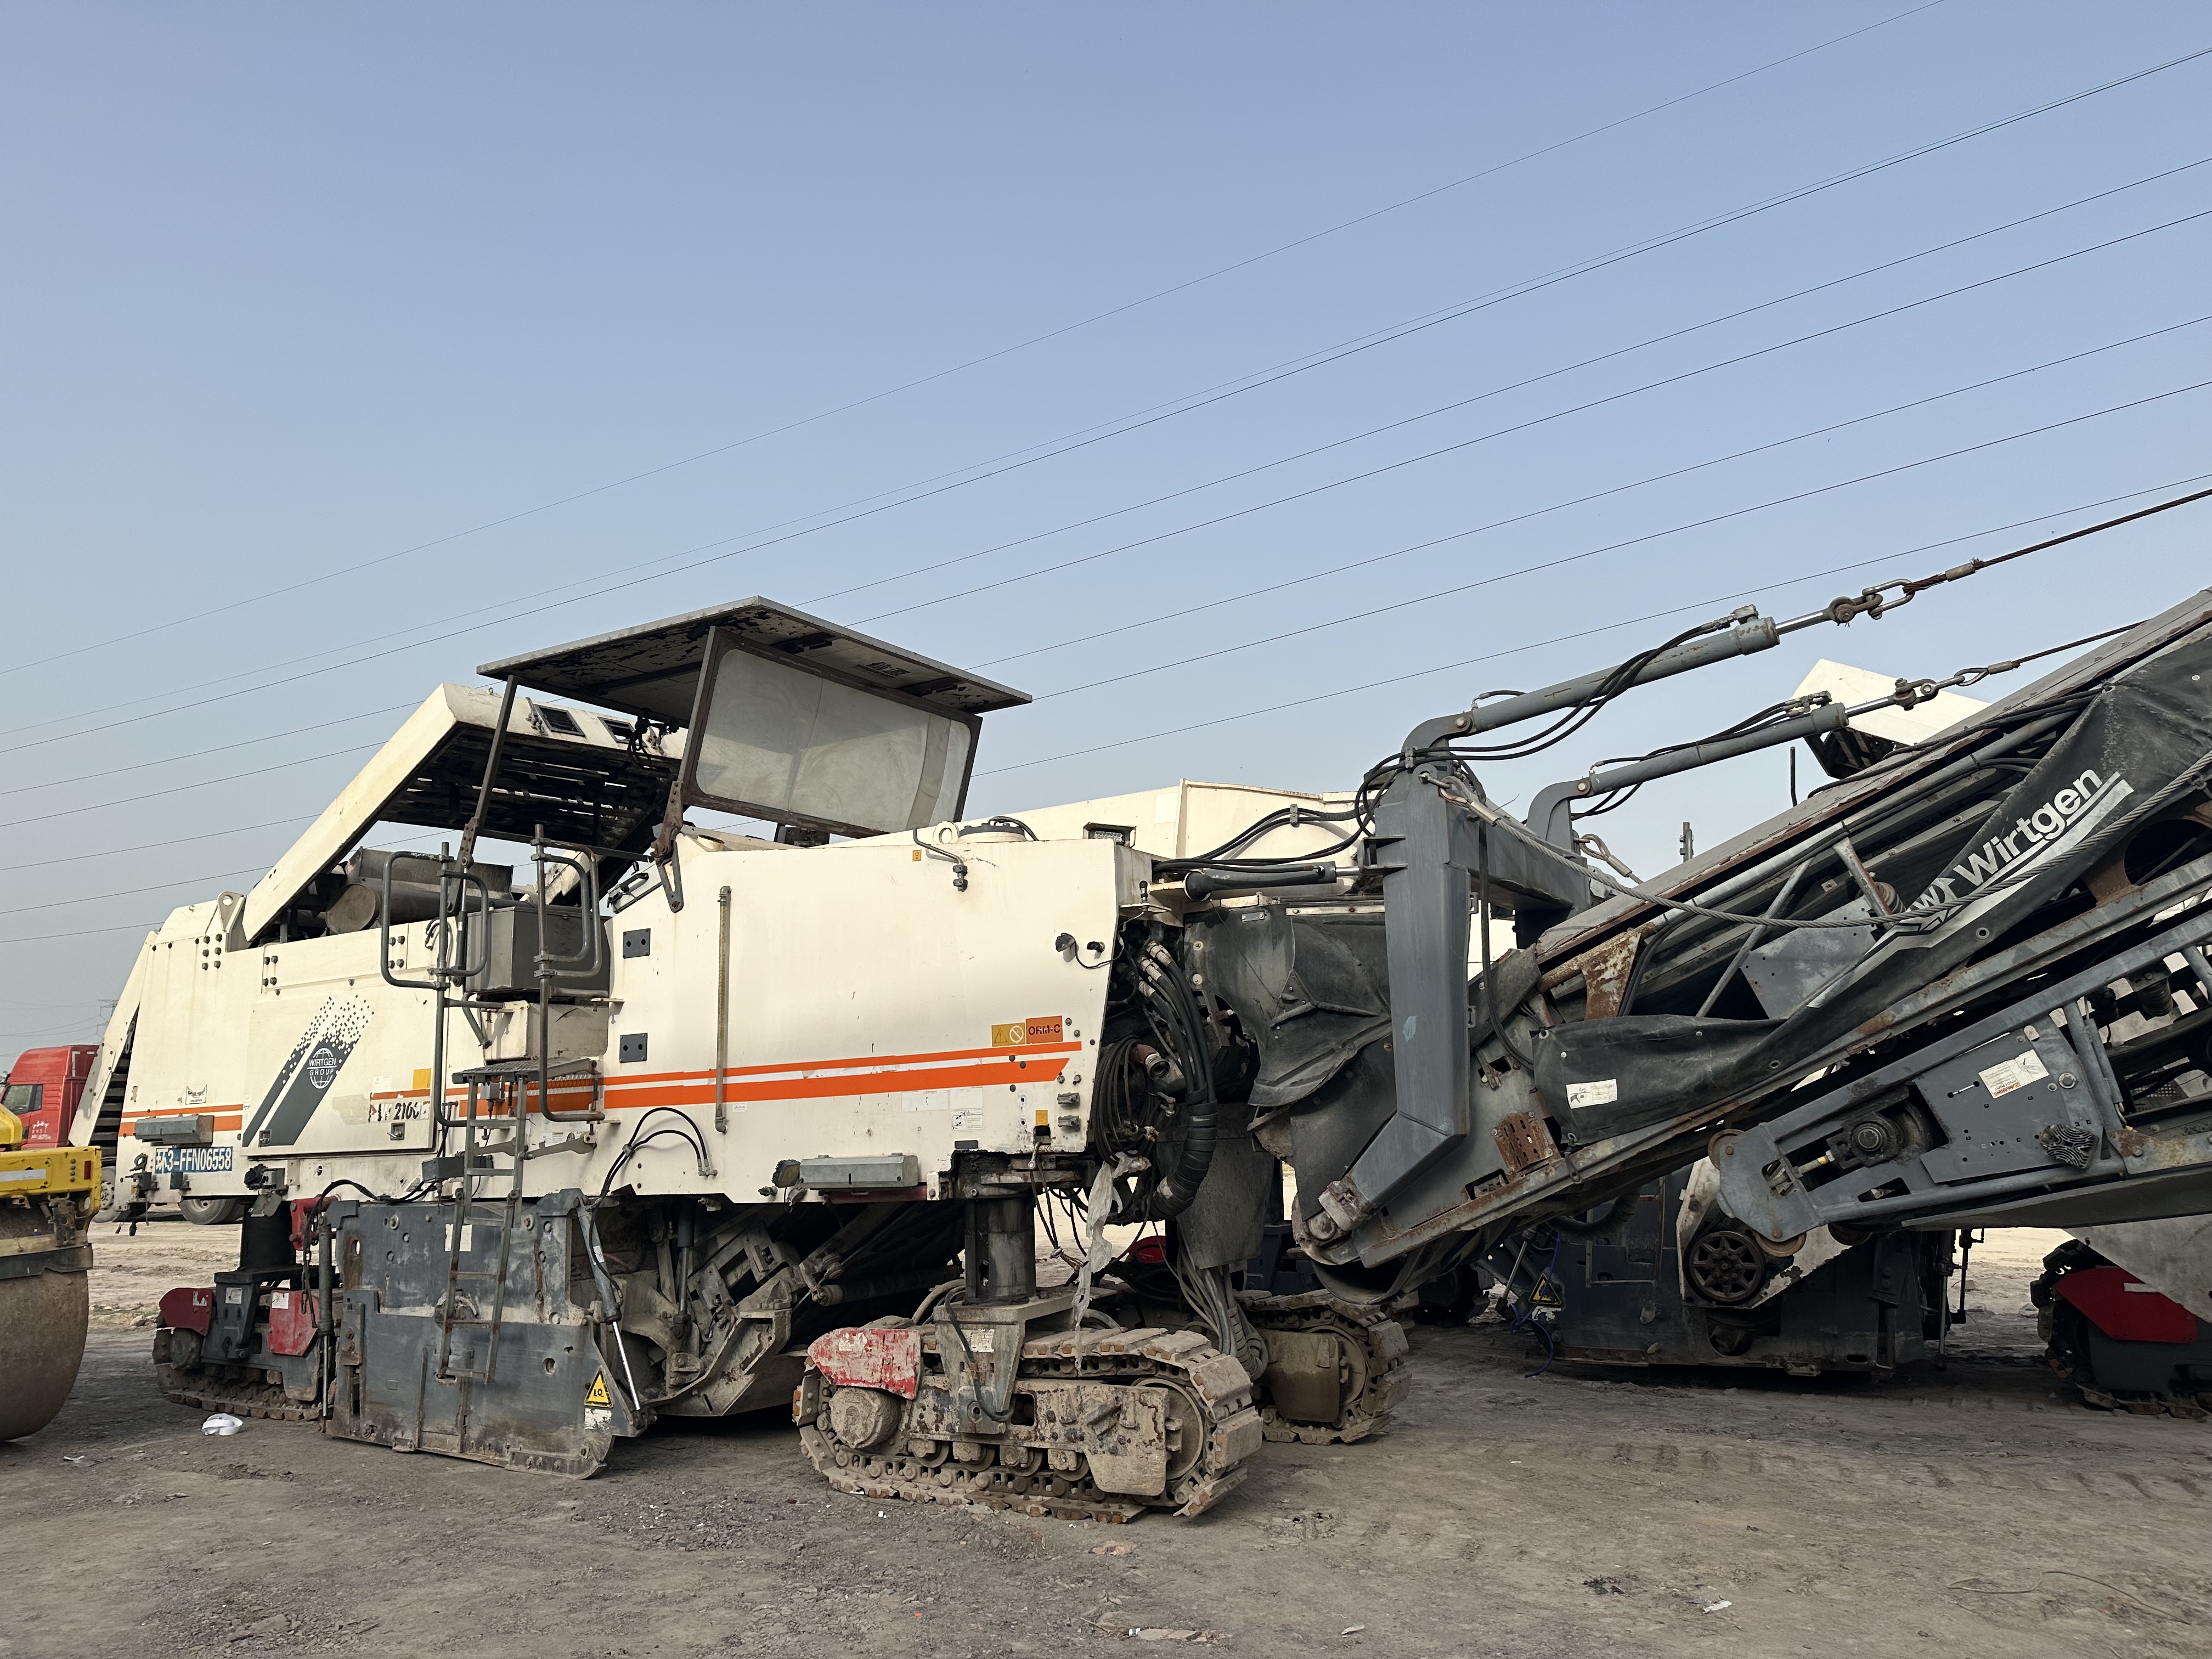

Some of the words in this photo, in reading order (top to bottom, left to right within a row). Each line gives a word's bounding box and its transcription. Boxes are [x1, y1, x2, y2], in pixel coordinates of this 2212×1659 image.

[1953, 769, 2103, 887] Wirtgen
[1028, 1024, 1060, 1035] ORM-C
[309, 1057, 336, 1067] WIRTGEN
[1994, 1085, 2015, 1096] WARNING
[156, 1148, 231, 1173] 环3-FFN06558
